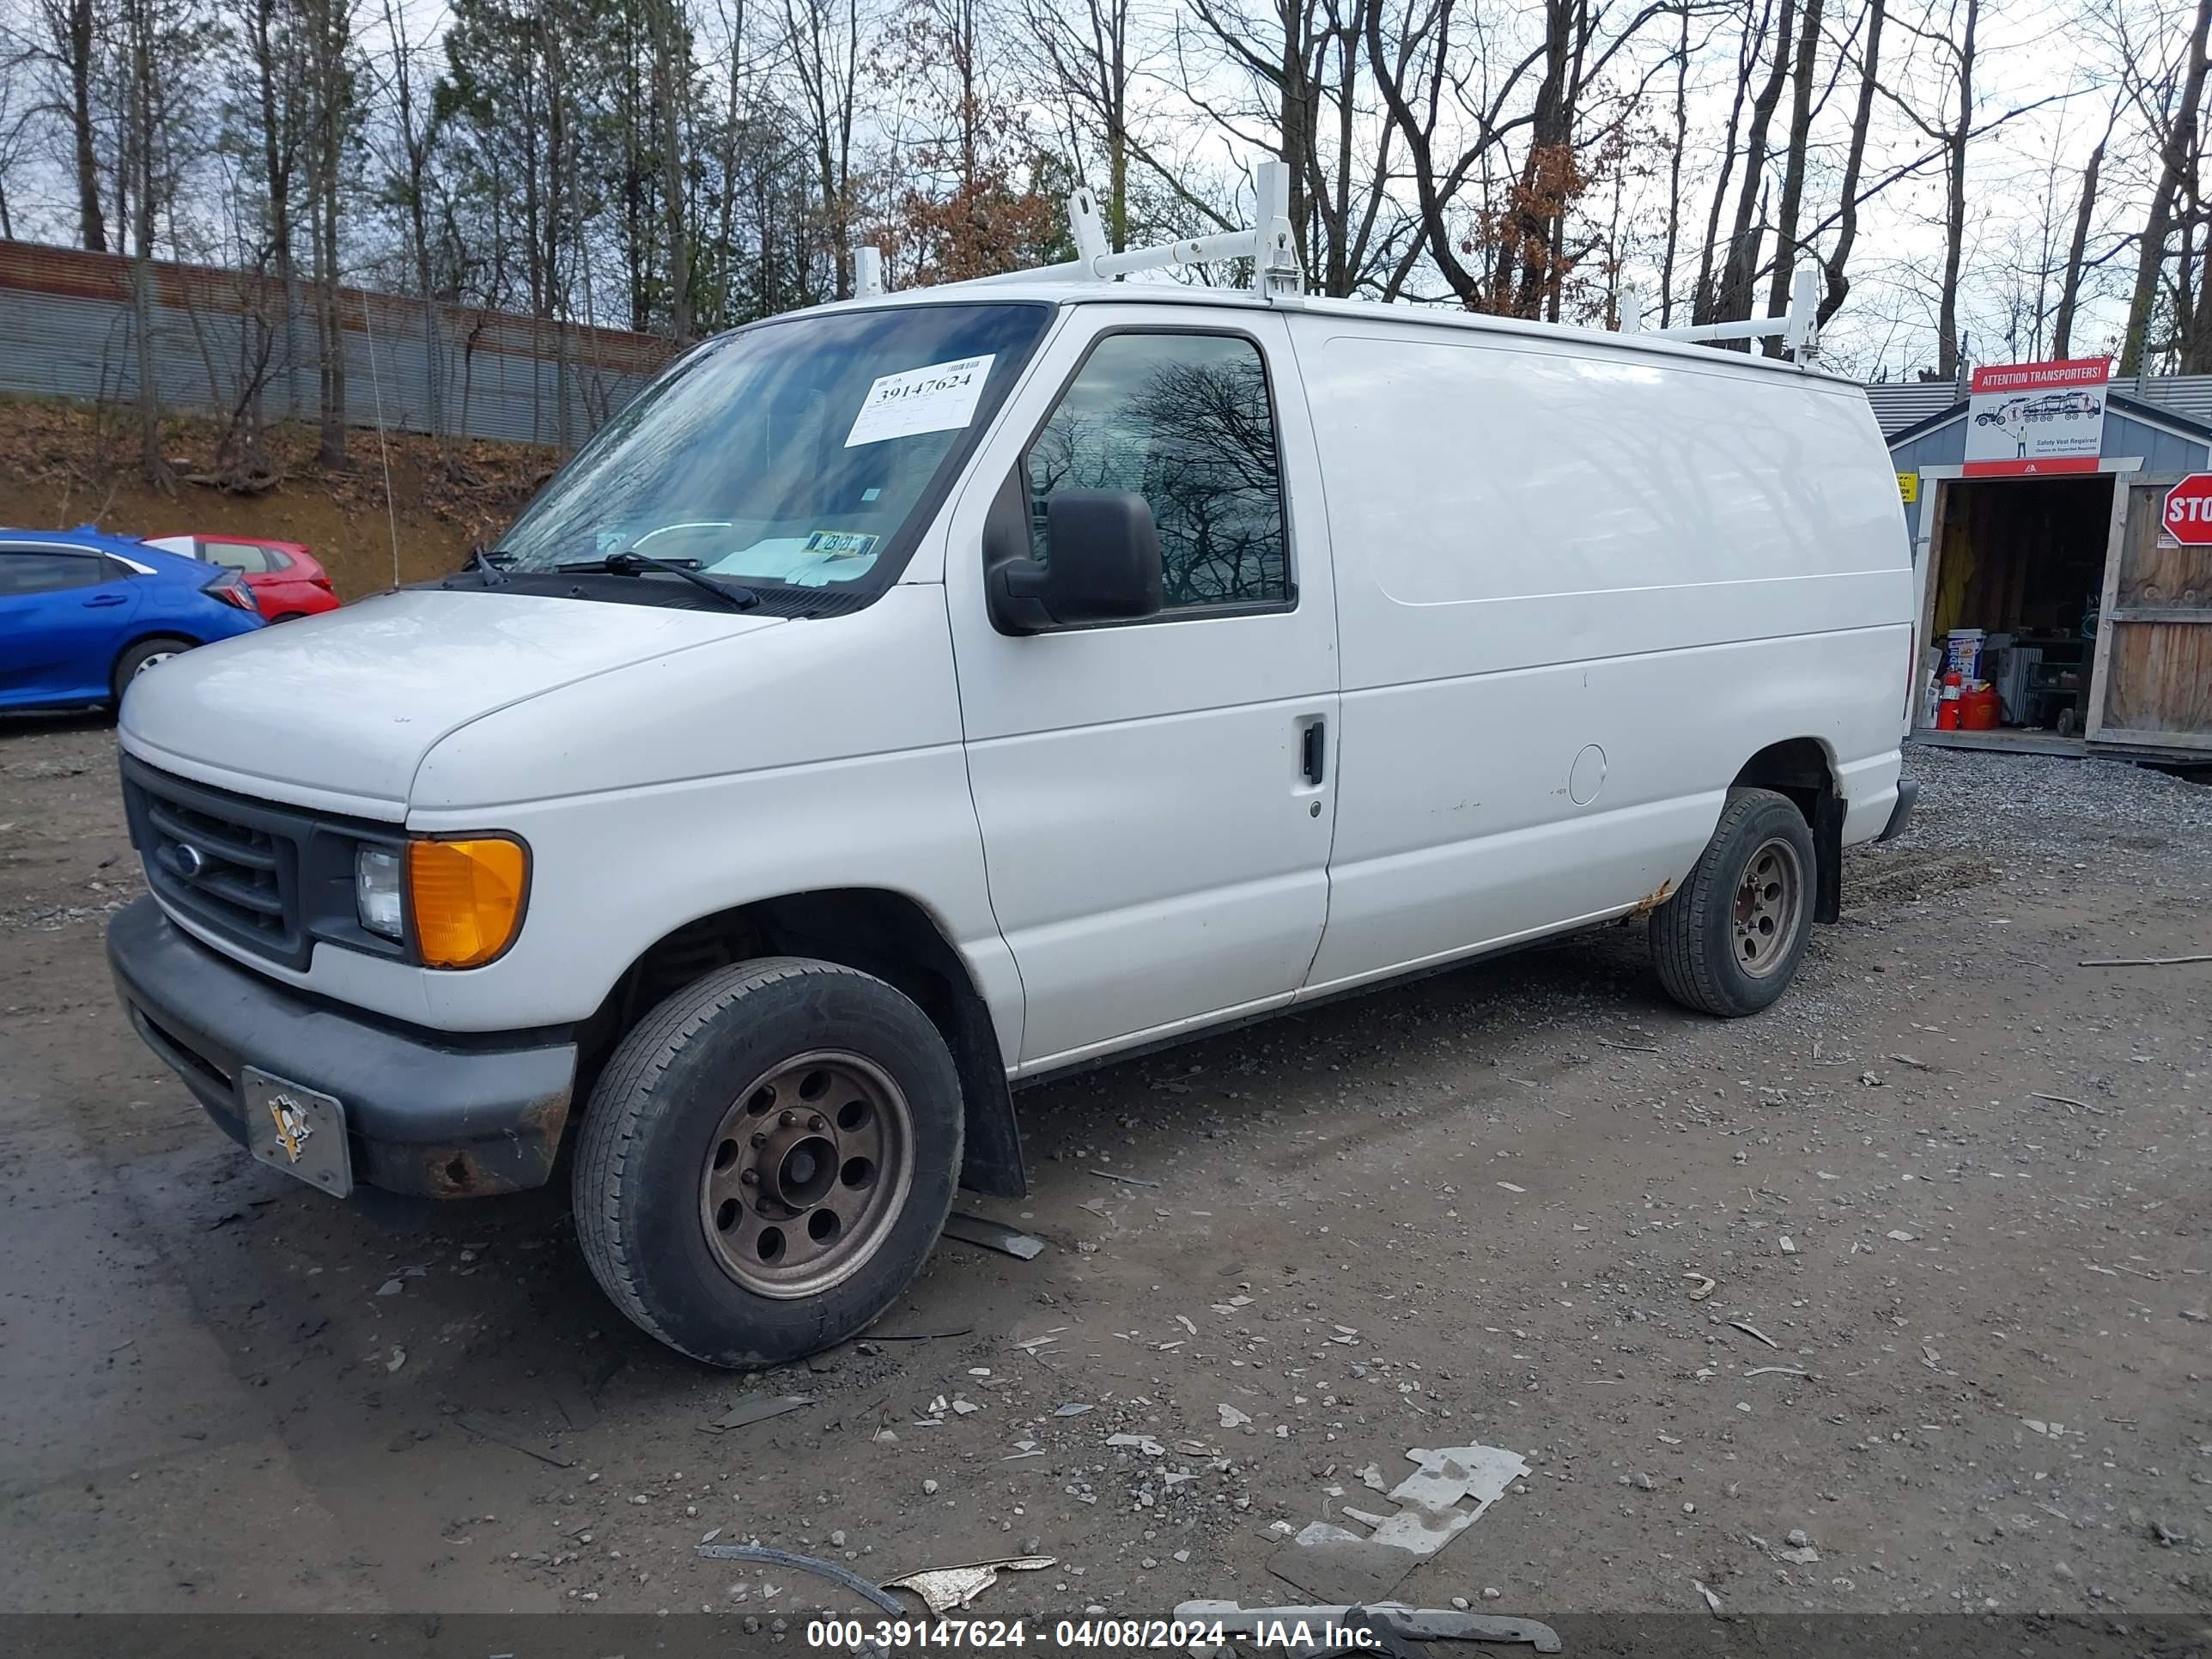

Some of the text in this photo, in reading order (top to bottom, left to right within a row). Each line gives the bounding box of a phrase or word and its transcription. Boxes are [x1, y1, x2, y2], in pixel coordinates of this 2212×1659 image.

[1982, 367, 2101, 386] ATTENTION TRANSPORTERS!
[875, 373, 972, 404] 39147624
[2070, 436, 2097, 446] Required
